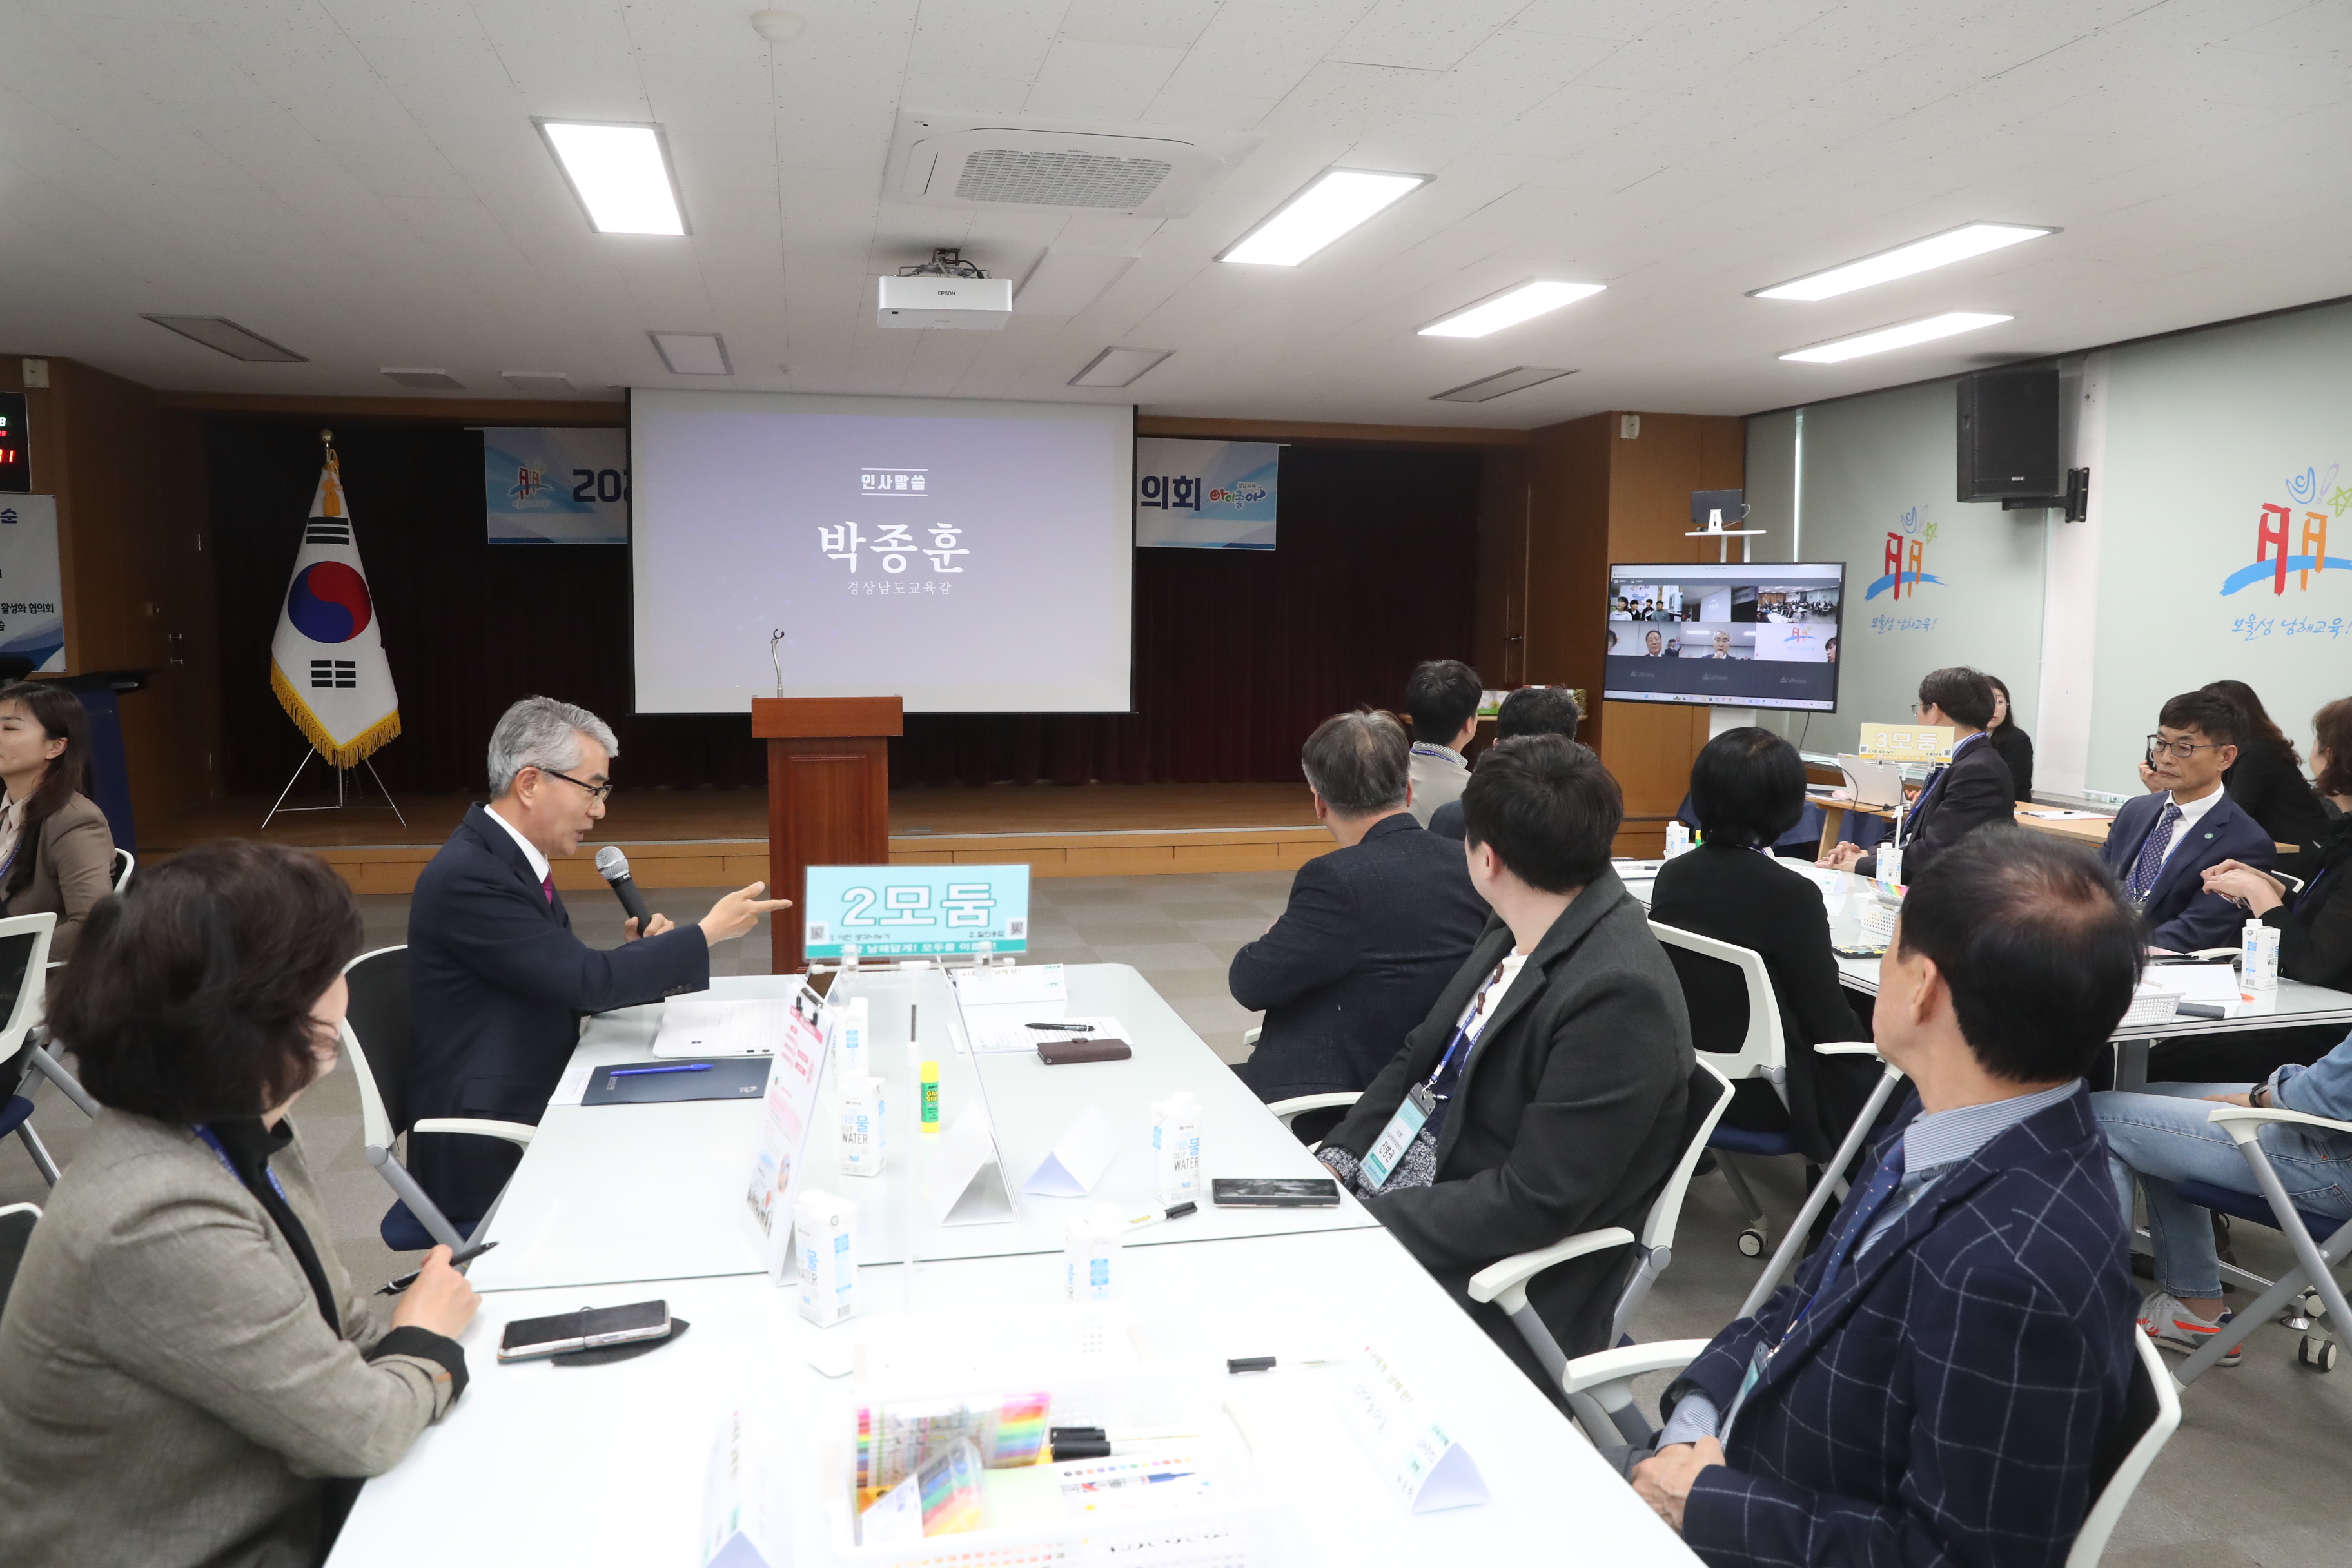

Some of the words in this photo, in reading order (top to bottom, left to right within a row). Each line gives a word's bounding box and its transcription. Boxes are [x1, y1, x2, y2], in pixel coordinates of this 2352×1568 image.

[861, 473, 926, 491] 인사말씀
[1141, 475, 1201, 511] 의회
[1209, 488, 1267, 509] 아이좋아
[816, 520, 970, 574] 박종훈
[846, 580, 952, 596] 경상남도교육감
[1, 602, 26, 614] 활성화
[28, 603, 54, 614] 협의회
[1874, 732, 1939, 752] 3모둠
[841, 882, 997, 928] 2모둠
[841, 1132, 868, 1144] WATER
[1173, 1156, 1199, 1171] WATER
